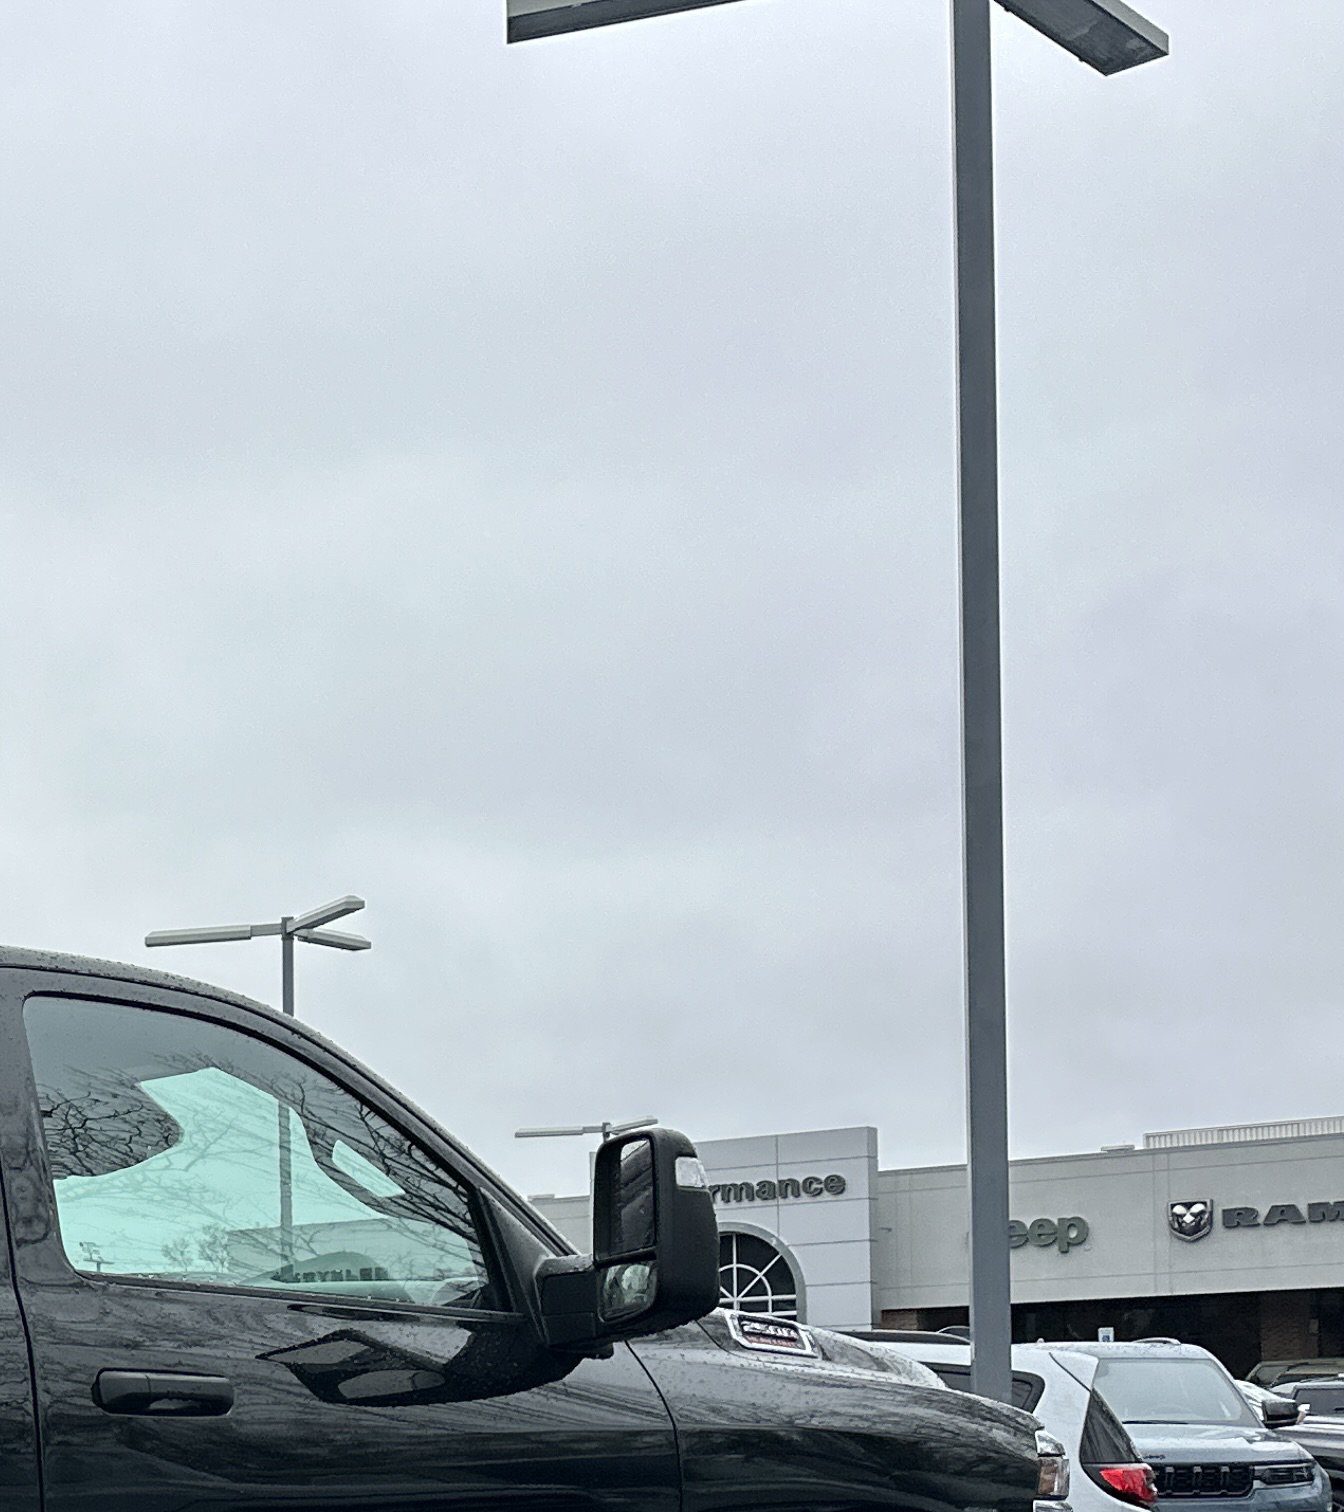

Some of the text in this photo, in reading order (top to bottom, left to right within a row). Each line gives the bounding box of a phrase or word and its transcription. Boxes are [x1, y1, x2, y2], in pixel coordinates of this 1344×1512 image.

[708, 1174, 846, 1203] rmance
[1222, 1201, 1344, 1228] RAM
[1009, 1216, 1089, 1254] eep
